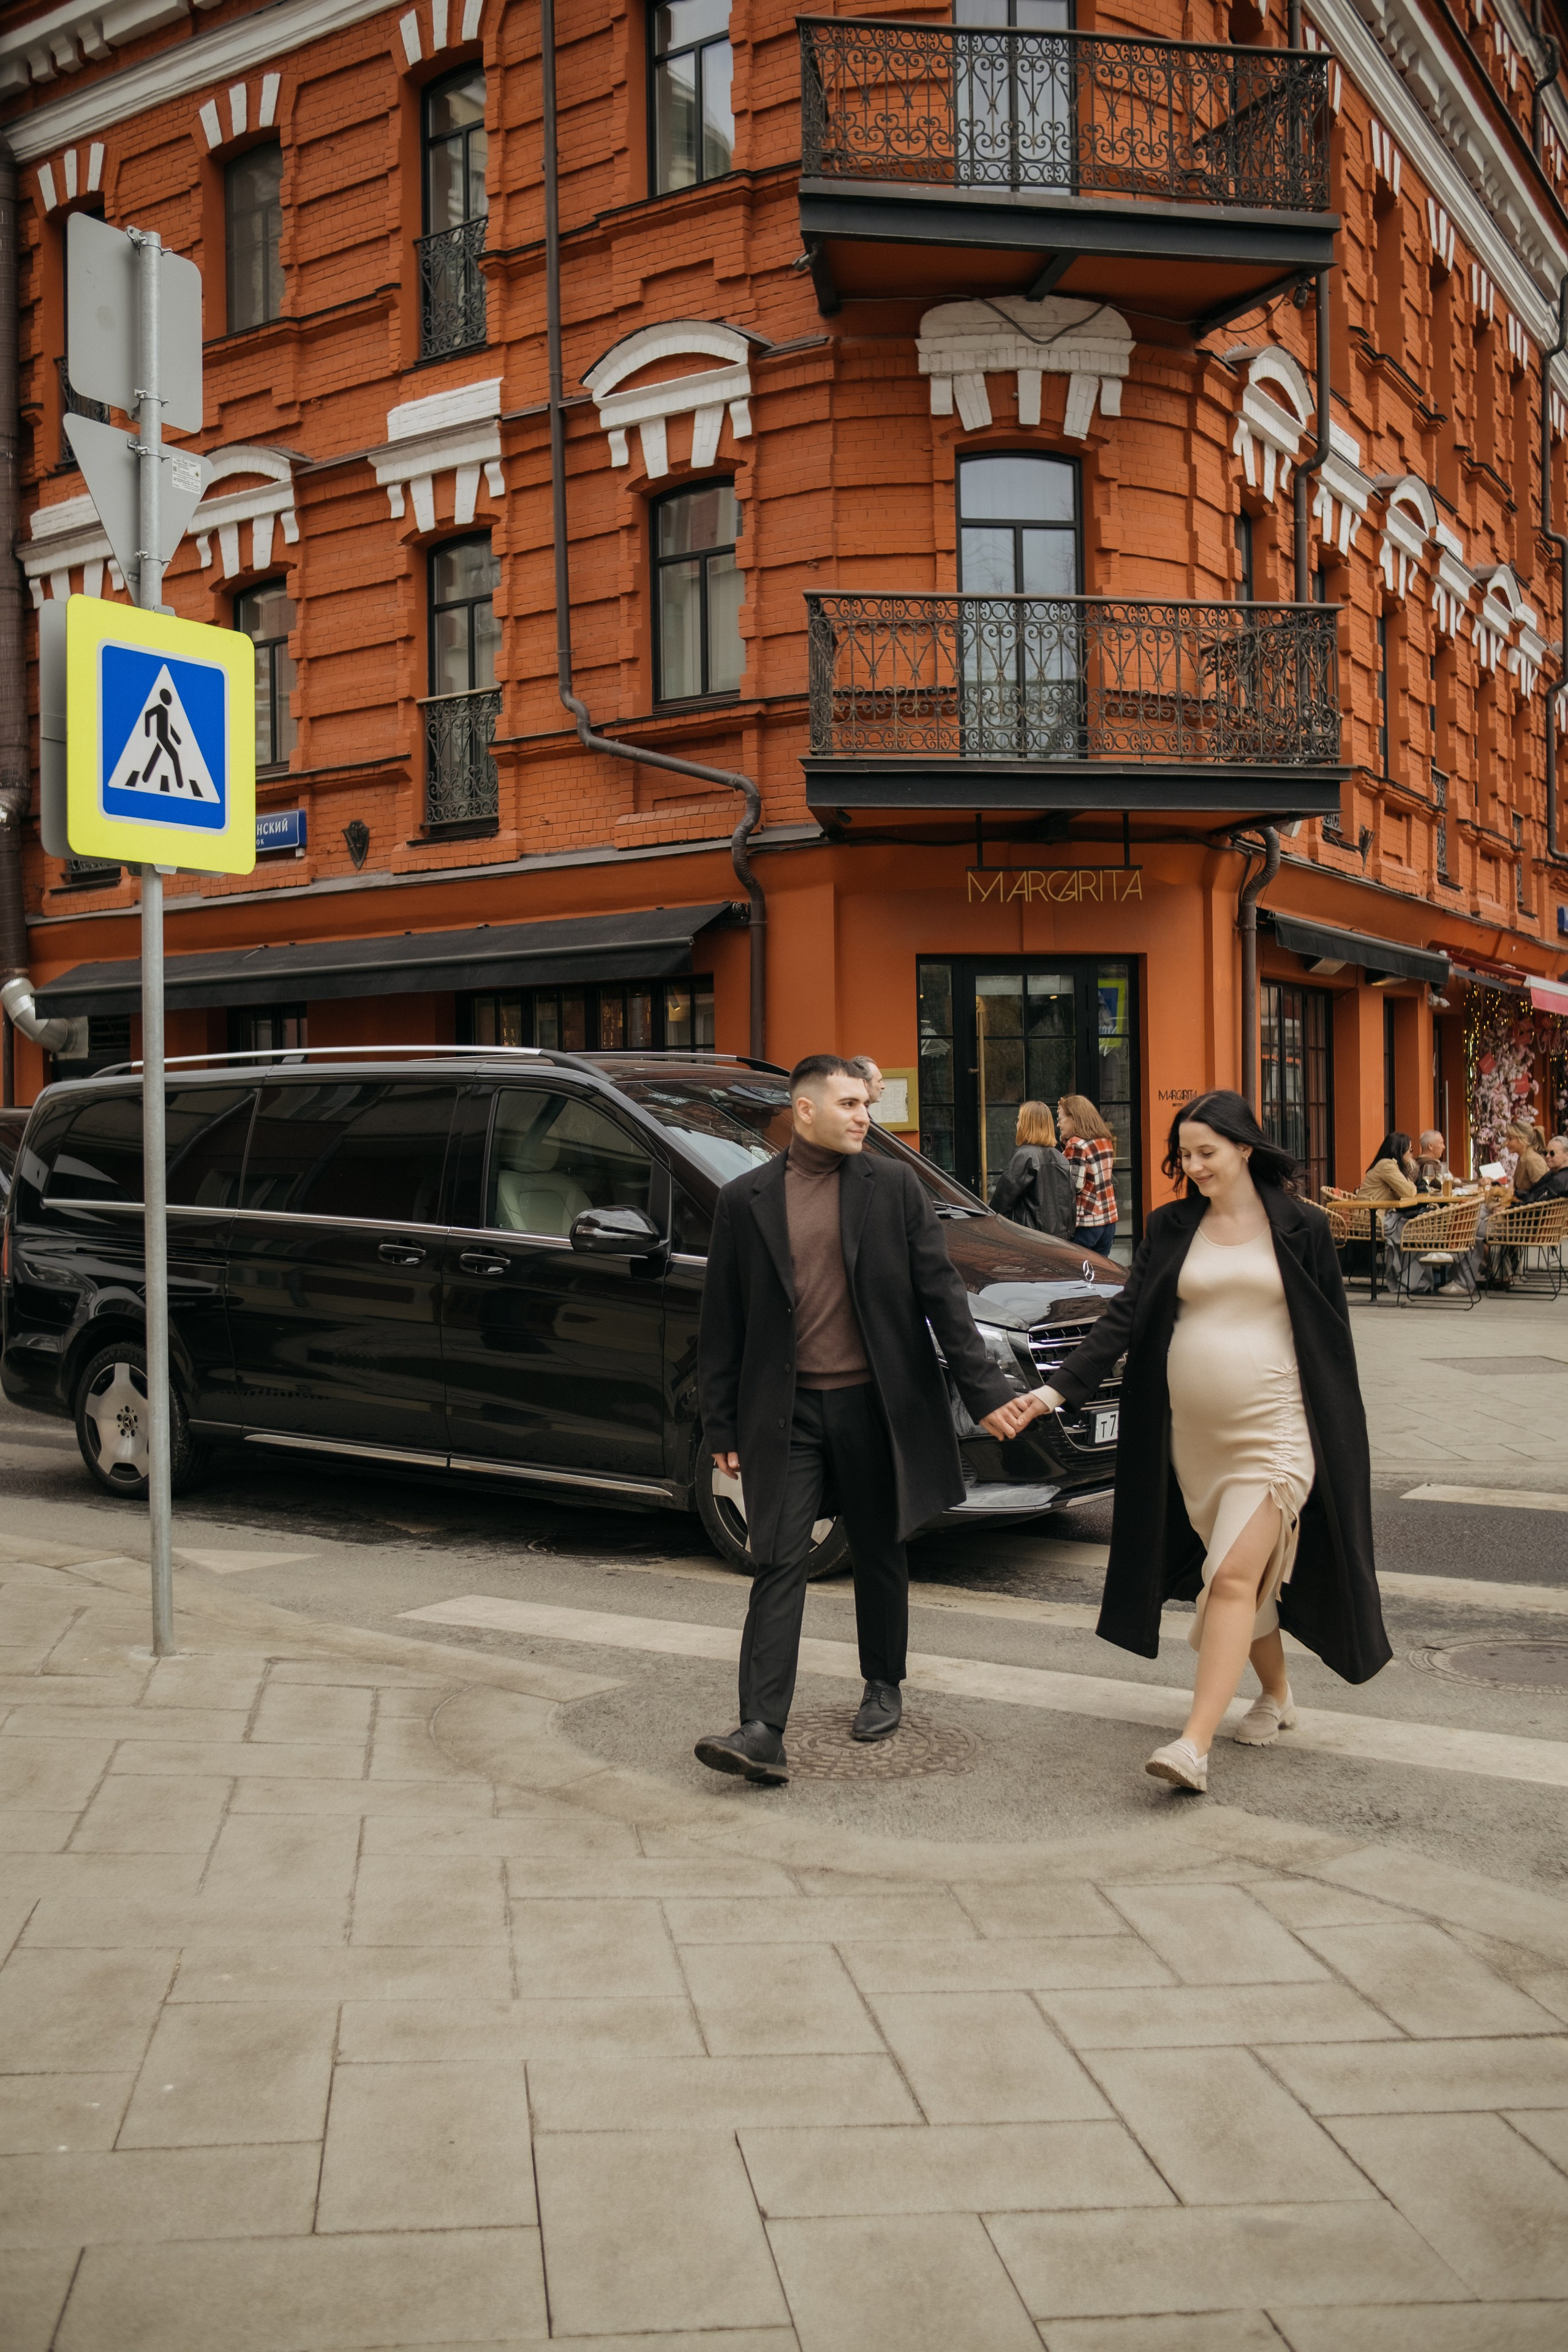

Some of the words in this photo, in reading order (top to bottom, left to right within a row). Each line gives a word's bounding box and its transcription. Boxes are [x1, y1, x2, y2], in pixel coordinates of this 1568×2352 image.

[257, 818, 288, 836] НСКИЙ
[967, 870, 1143, 903] MARGARITA
[1158, 1090, 1197, 1101] MARGARITA
[1101, 1414, 1117, 1438] T7
